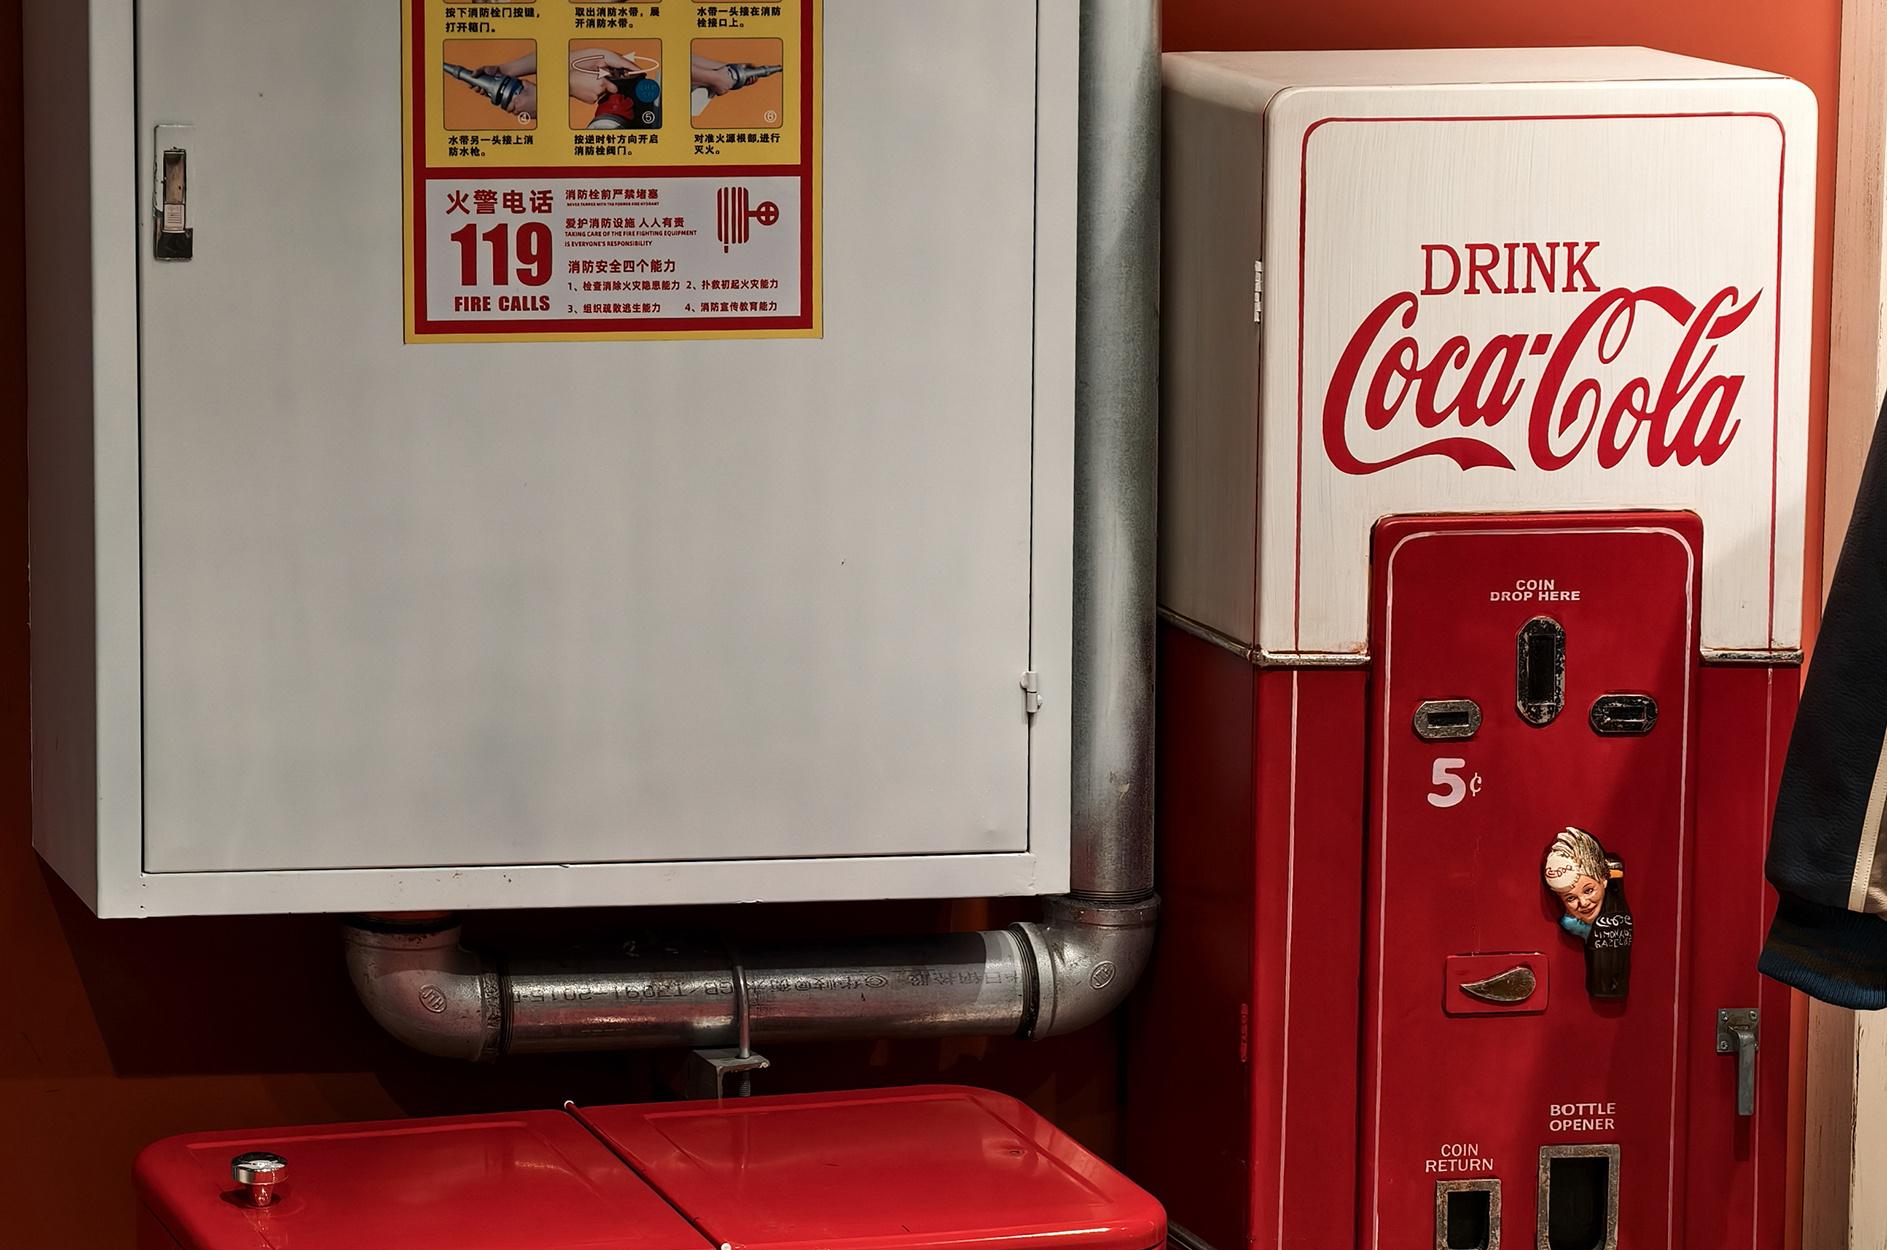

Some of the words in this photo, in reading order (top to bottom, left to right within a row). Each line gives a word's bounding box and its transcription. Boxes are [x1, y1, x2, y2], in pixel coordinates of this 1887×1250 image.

[696, 6, 782, 17] 水带一头接在消防
[444, 21, 497, 34] 打开箱门。
[574, 18, 635, 29] 开消防水带。
[696, 17, 746, 28] 栓接口上。
[447, 134, 535, 146] 水带另一头接上消
[573, 133, 660, 145] 按逆时针方向开启
[447, 145, 487, 157] 防水枪。
[573, 145, 633, 156] 消防栓阀门。
[693, 144, 721, 155] 灭火。
[564, 188, 660, 200] 消防栓前严禁堵塞
[445, 188, 555, 216] 火警电话
[564, 217, 636, 229] 爱护消防设施
[638, 216, 686, 228] 人人有责
[450, 221, 554, 287] 119
[567, 259, 677, 274] 消防安全四个能力
[1420, 240, 1601, 297] DRINK
[454, 296, 492, 313] FIRE
[498, 295, 551, 312] CALLS
[1322, 285, 1764, 476] Coca-Cola
[1515, 579, 1555, 591] COIN
[1489, 590, 1534, 602] DROP
[1538, 590, 1581, 601] HERE
[1550, 1103, 1616, 1117] BOTTLE
[1549, 1118, 1615, 1132] OPENER
[1441, 1144, 1479, 1157] COIN
[1425, 1158, 1494, 1173] RETURN
